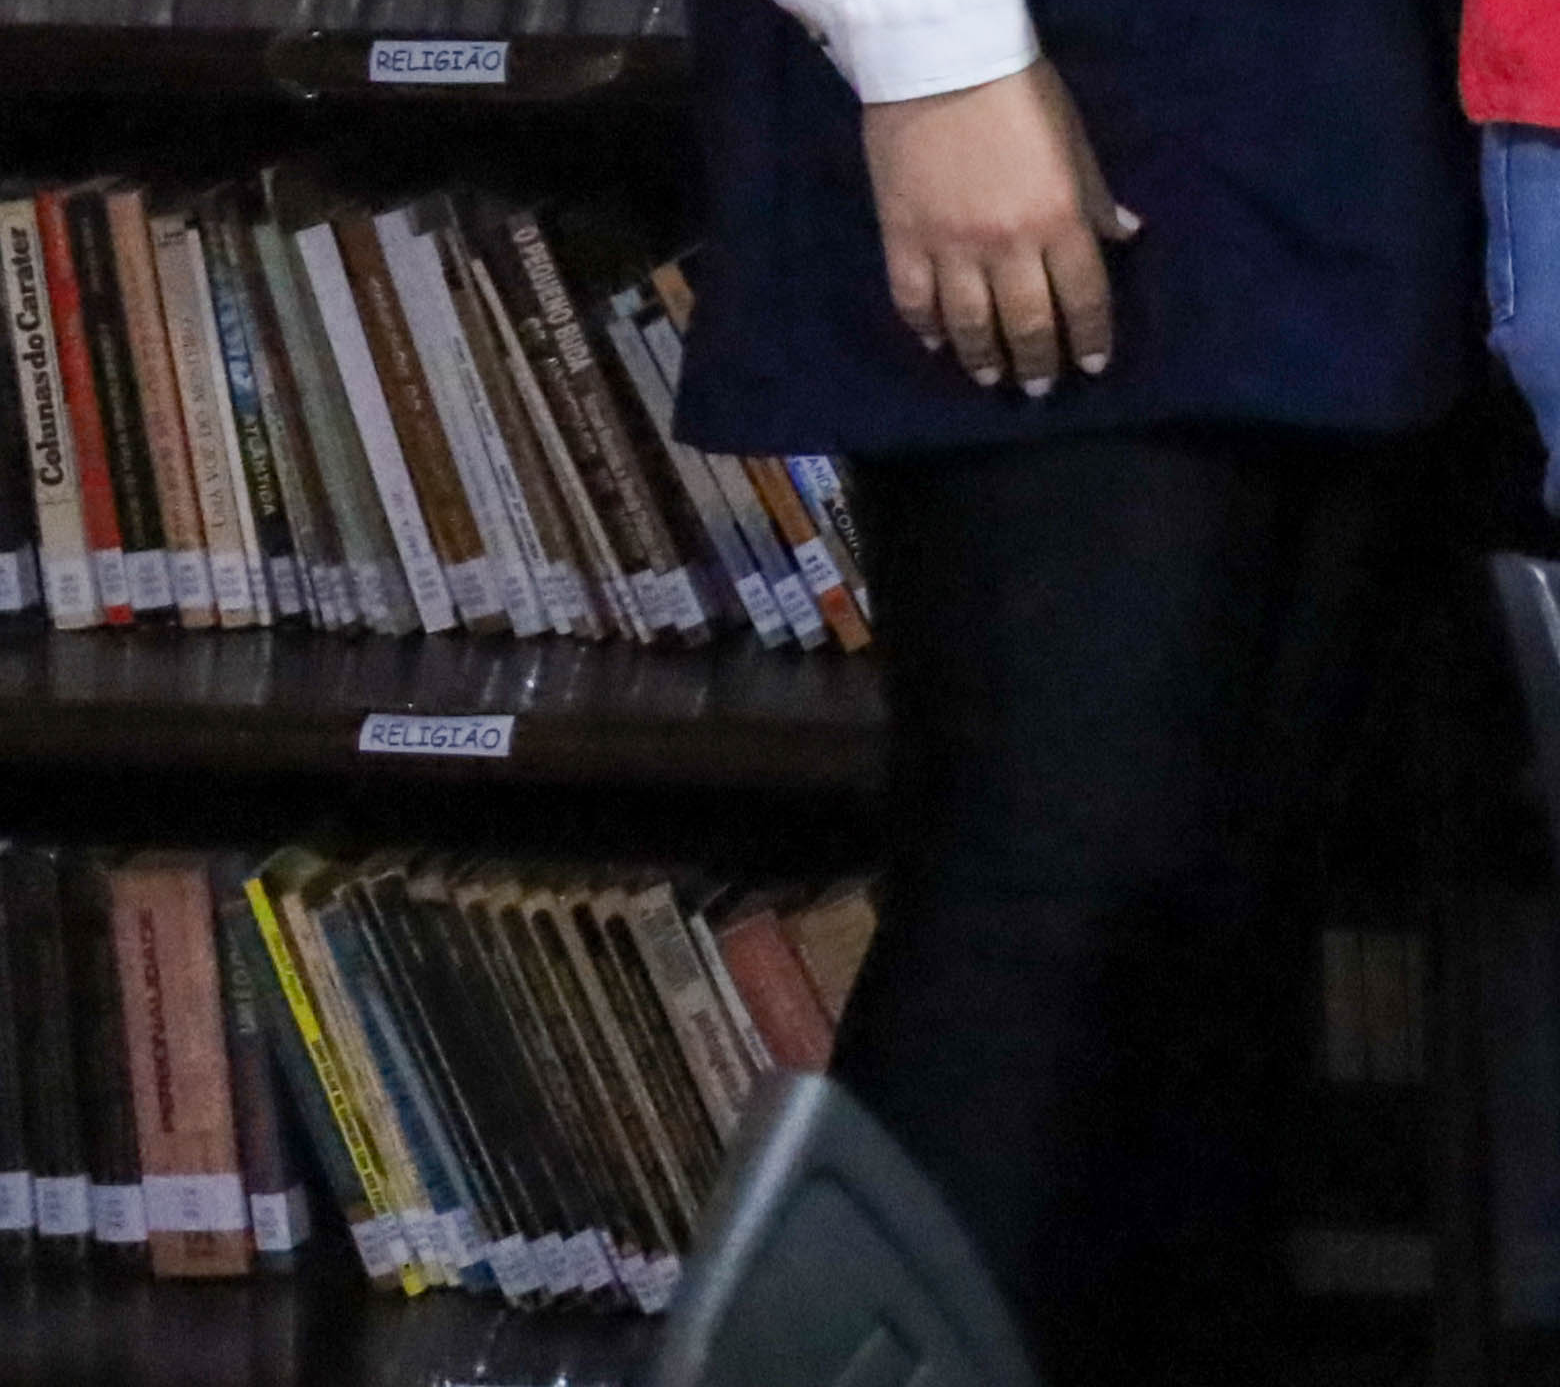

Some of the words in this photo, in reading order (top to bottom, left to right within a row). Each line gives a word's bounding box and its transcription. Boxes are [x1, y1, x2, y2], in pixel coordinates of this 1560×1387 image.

[377, 45, 501, 73] RELIGIÃO
[509, 222, 539, 247] O
[516, 238, 578, 327] PEQUENO
[19, 333, 47, 370] do
[25, 369, 64, 487] Colunas
[371, 723, 502, 751] RELIGIÃO
